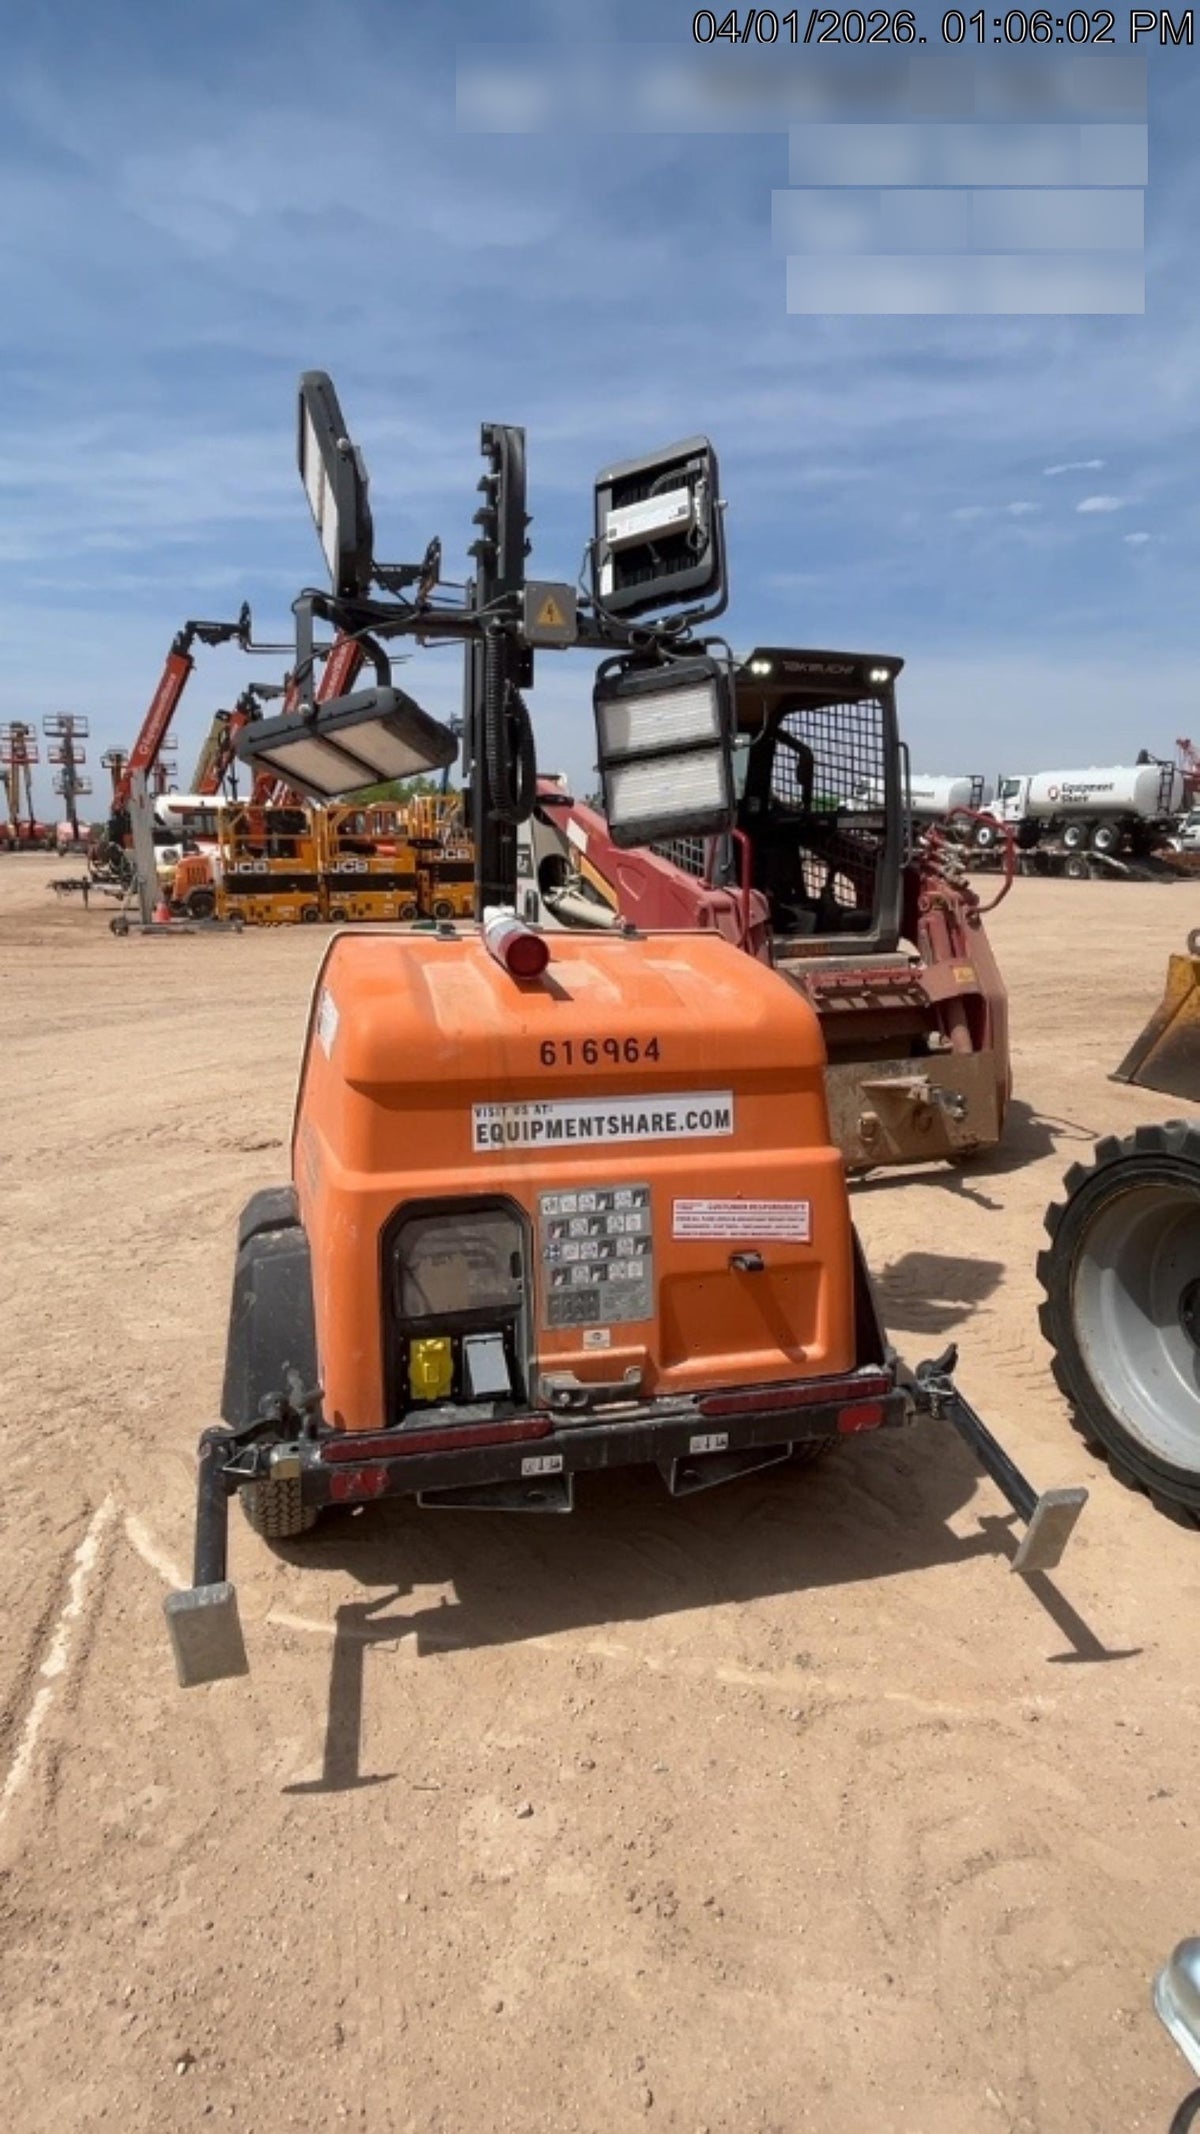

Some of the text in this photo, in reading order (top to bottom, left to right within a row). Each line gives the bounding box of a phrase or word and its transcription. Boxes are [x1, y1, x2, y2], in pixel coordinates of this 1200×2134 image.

[540, 1037, 661, 1066] 616964
[474, 1106, 507, 1118] VISIT
[514, 1104, 528, 1115] US
[476, 1109, 731, 1144] EQUIPMENTSHARE.COM
